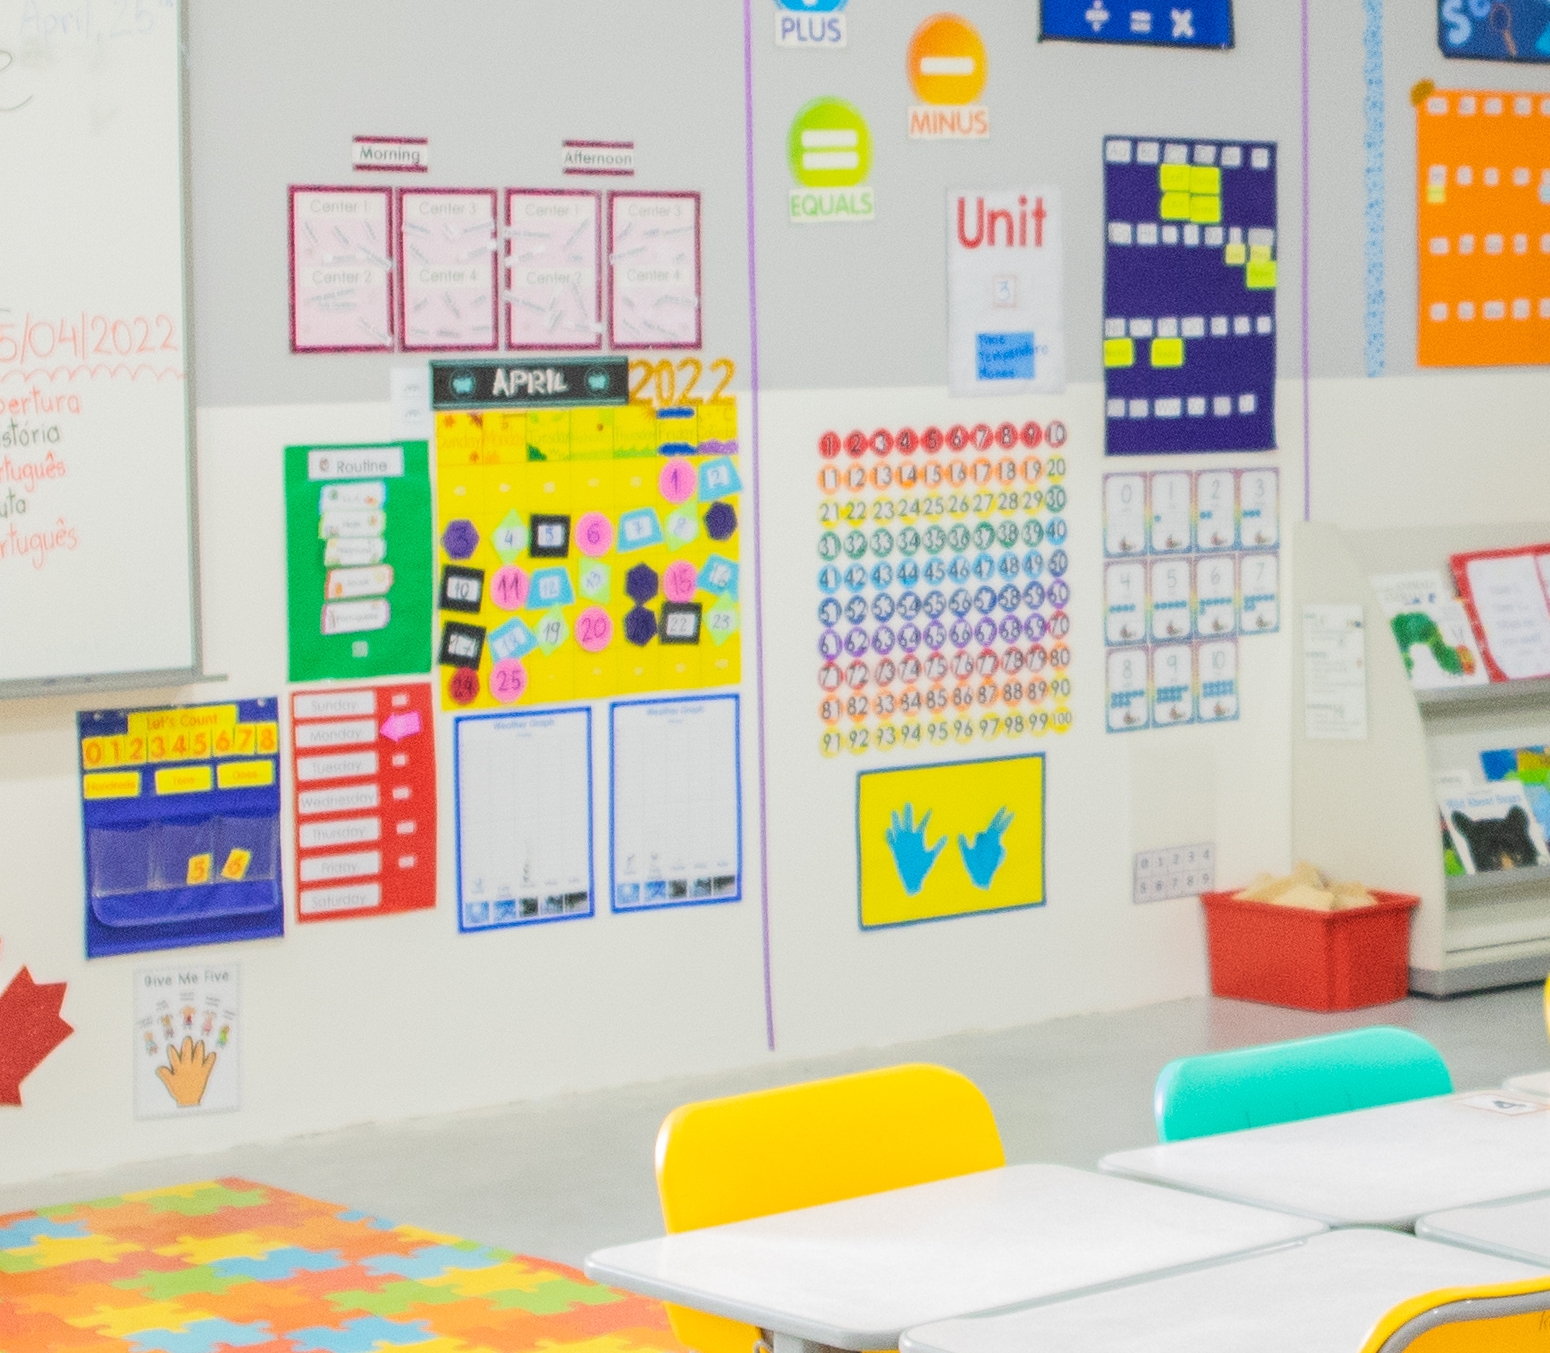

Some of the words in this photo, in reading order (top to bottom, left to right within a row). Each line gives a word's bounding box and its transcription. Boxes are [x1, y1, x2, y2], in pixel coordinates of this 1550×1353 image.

[781, 16, 841, 42] PLUS
[910, 110, 988, 135] MINUS
[360, 146, 420, 164] Morning
[564, 152, 632, 165] Afternoon
[310, 200, 358, 213] Center
[419, 202, 466, 215] Center
[791, 192, 873, 216] EQUALS
[957, 195, 1047, 249] Unit
[312, 270, 359, 284] Center
[492, 369, 568, 396] APRIL
[628, 357, 736, 407] 2022
[337, 459, 387, 474] Routine
[823, 470, 837, 487] 11
[848, 469, 864, 486] 12
[875, 467, 892, 484] 13
[925, 466, 941, 482] 15
[950, 464, 966, 481] 16
[975, 464, 991, 482] 17
[998, 463, 1015, 479] 18
[1025, 462, 1041, 479] 19
[1047, 459, 1065, 475] 20
[671, 469, 678, 492] 1
[821, 502, 838, 521] 21
[847, 502, 866, 519] 22
[874, 502, 894, 519] 23
[900, 499, 920, 516] 24
[924, 499, 944, 515] 25
[950, 496, 969, 513] 26
[973, 494, 994, 511] 27
[998, 493, 1018, 509] 28
[1023, 491, 1043, 509] 29
[1047, 490, 1066, 507] 30
[504, 533, 513, 547] 4
[545, 526, 554, 543] 5
[587, 526, 600, 544] 6
[455, 580, 470, 598] 10
[500, 573, 520, 603] 11
[582, 617, 607, 642] 20
[499, 669, 520, 691] 25
[311, 699, 357, 713] Sunday
[180, 713, 218, 727] Count
[310, 728, 361, 742] Monday
[824, 733, 840, 750] 91
[850, 729, 868, 747] 92
[902, 726, 920, 742] 94
[928, 723, 947, 740] 95
[954, 721, 972, 737] 96
[980, 718, 999, 735] 97
[1006, 715, 1024, 733] 98
[1029, 714, 1048, 730] 99
[85, 742, 102, 765] 0
[130, 737, 144, 763] 2
[151, 736, 166, 759] 3
[172, 735, 187, 756] 4
[194, 732, 207, 756] 5
[216, 730, 230, 752] 6
[239, 729, 251, 751] 7
[261, 729, 274, 750] 8
[312, 760, 360, 774] Tuesday
[301, 793, 375, 808] Wednesday
[312, 826, 365, 840] Thursday
[321, 861, 357, 874] Friday
[312, 894, 365, 908] Saturday
[178, 973, 198, 984] Me
[205, 970, 229, 982] Five
